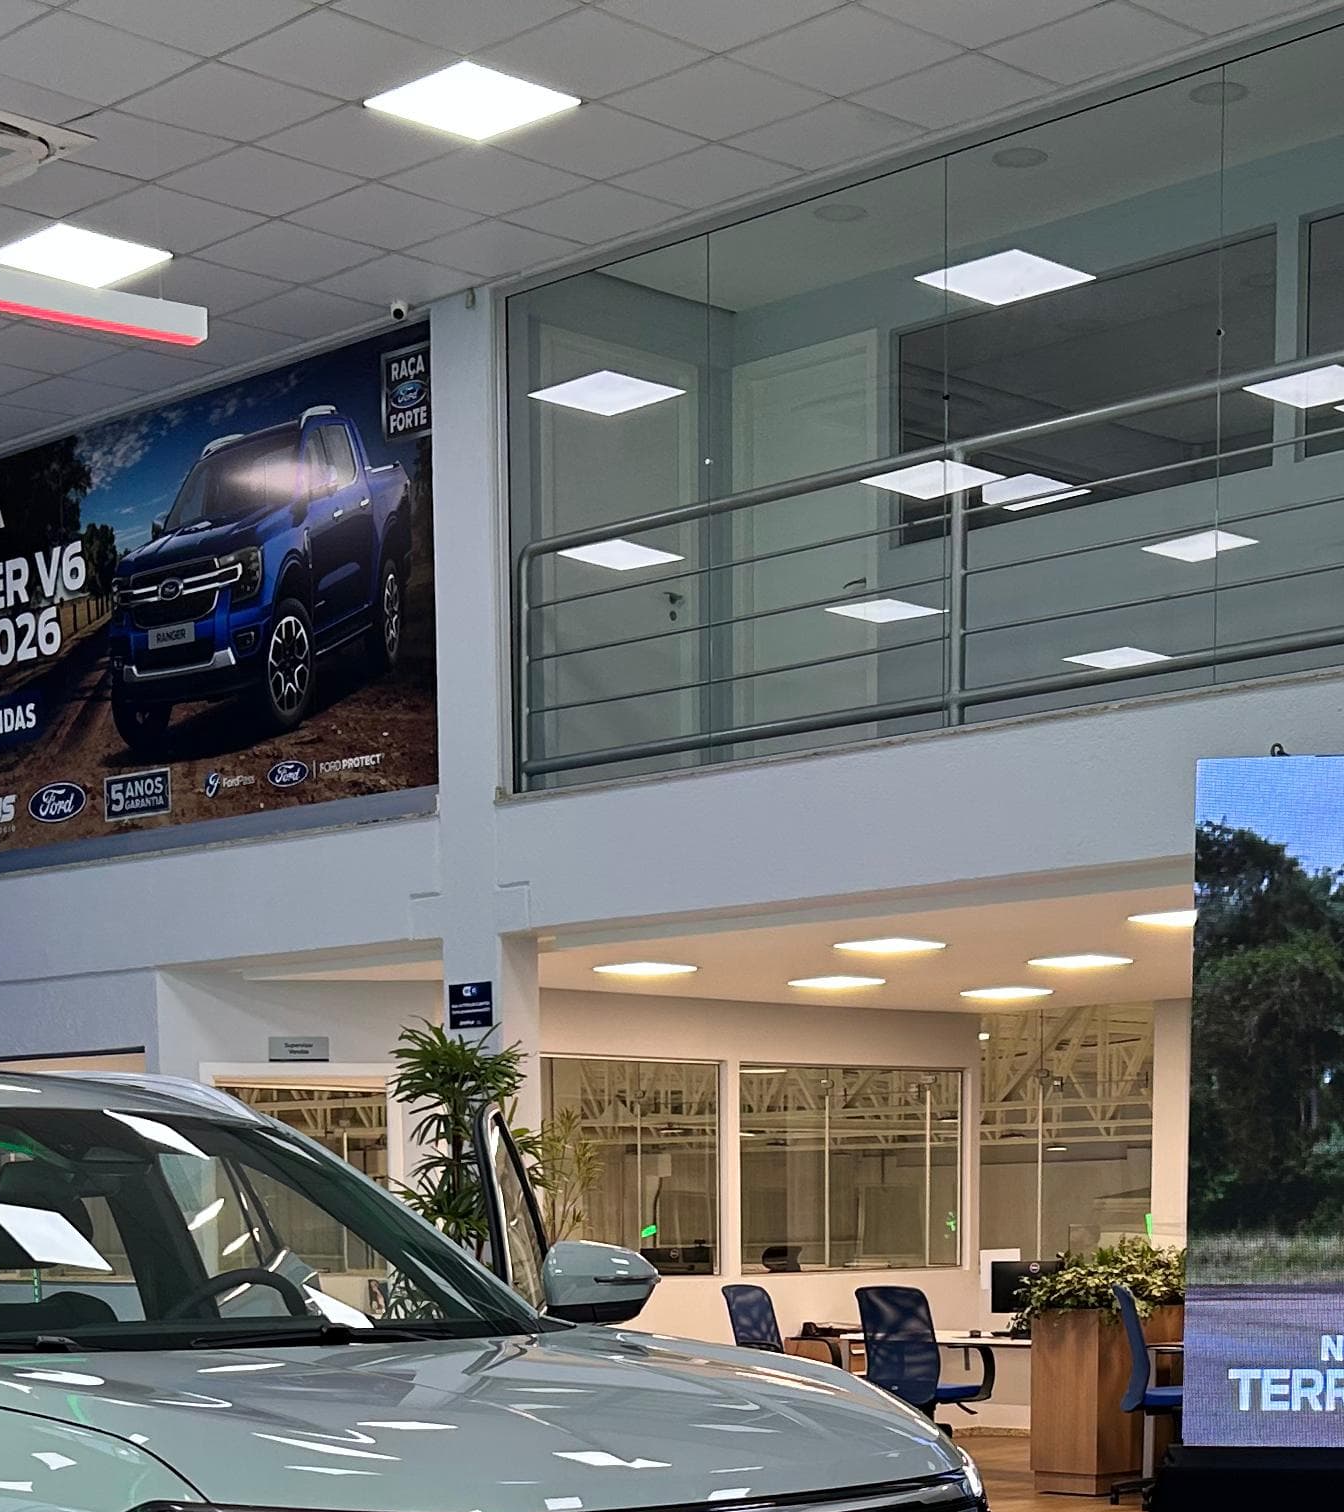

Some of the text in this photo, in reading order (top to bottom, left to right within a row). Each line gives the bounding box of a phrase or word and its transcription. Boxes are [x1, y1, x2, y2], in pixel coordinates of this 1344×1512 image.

[391, 354, 425, 381] RAÇA
[389, 405, 427, 434] FORTE
[34, 540, 86, 598] V6
[274, 763, 301, 784] Ford
[39, 788, 76, 816] Ford
[111, 776, 164, 812] 5 ANOS
